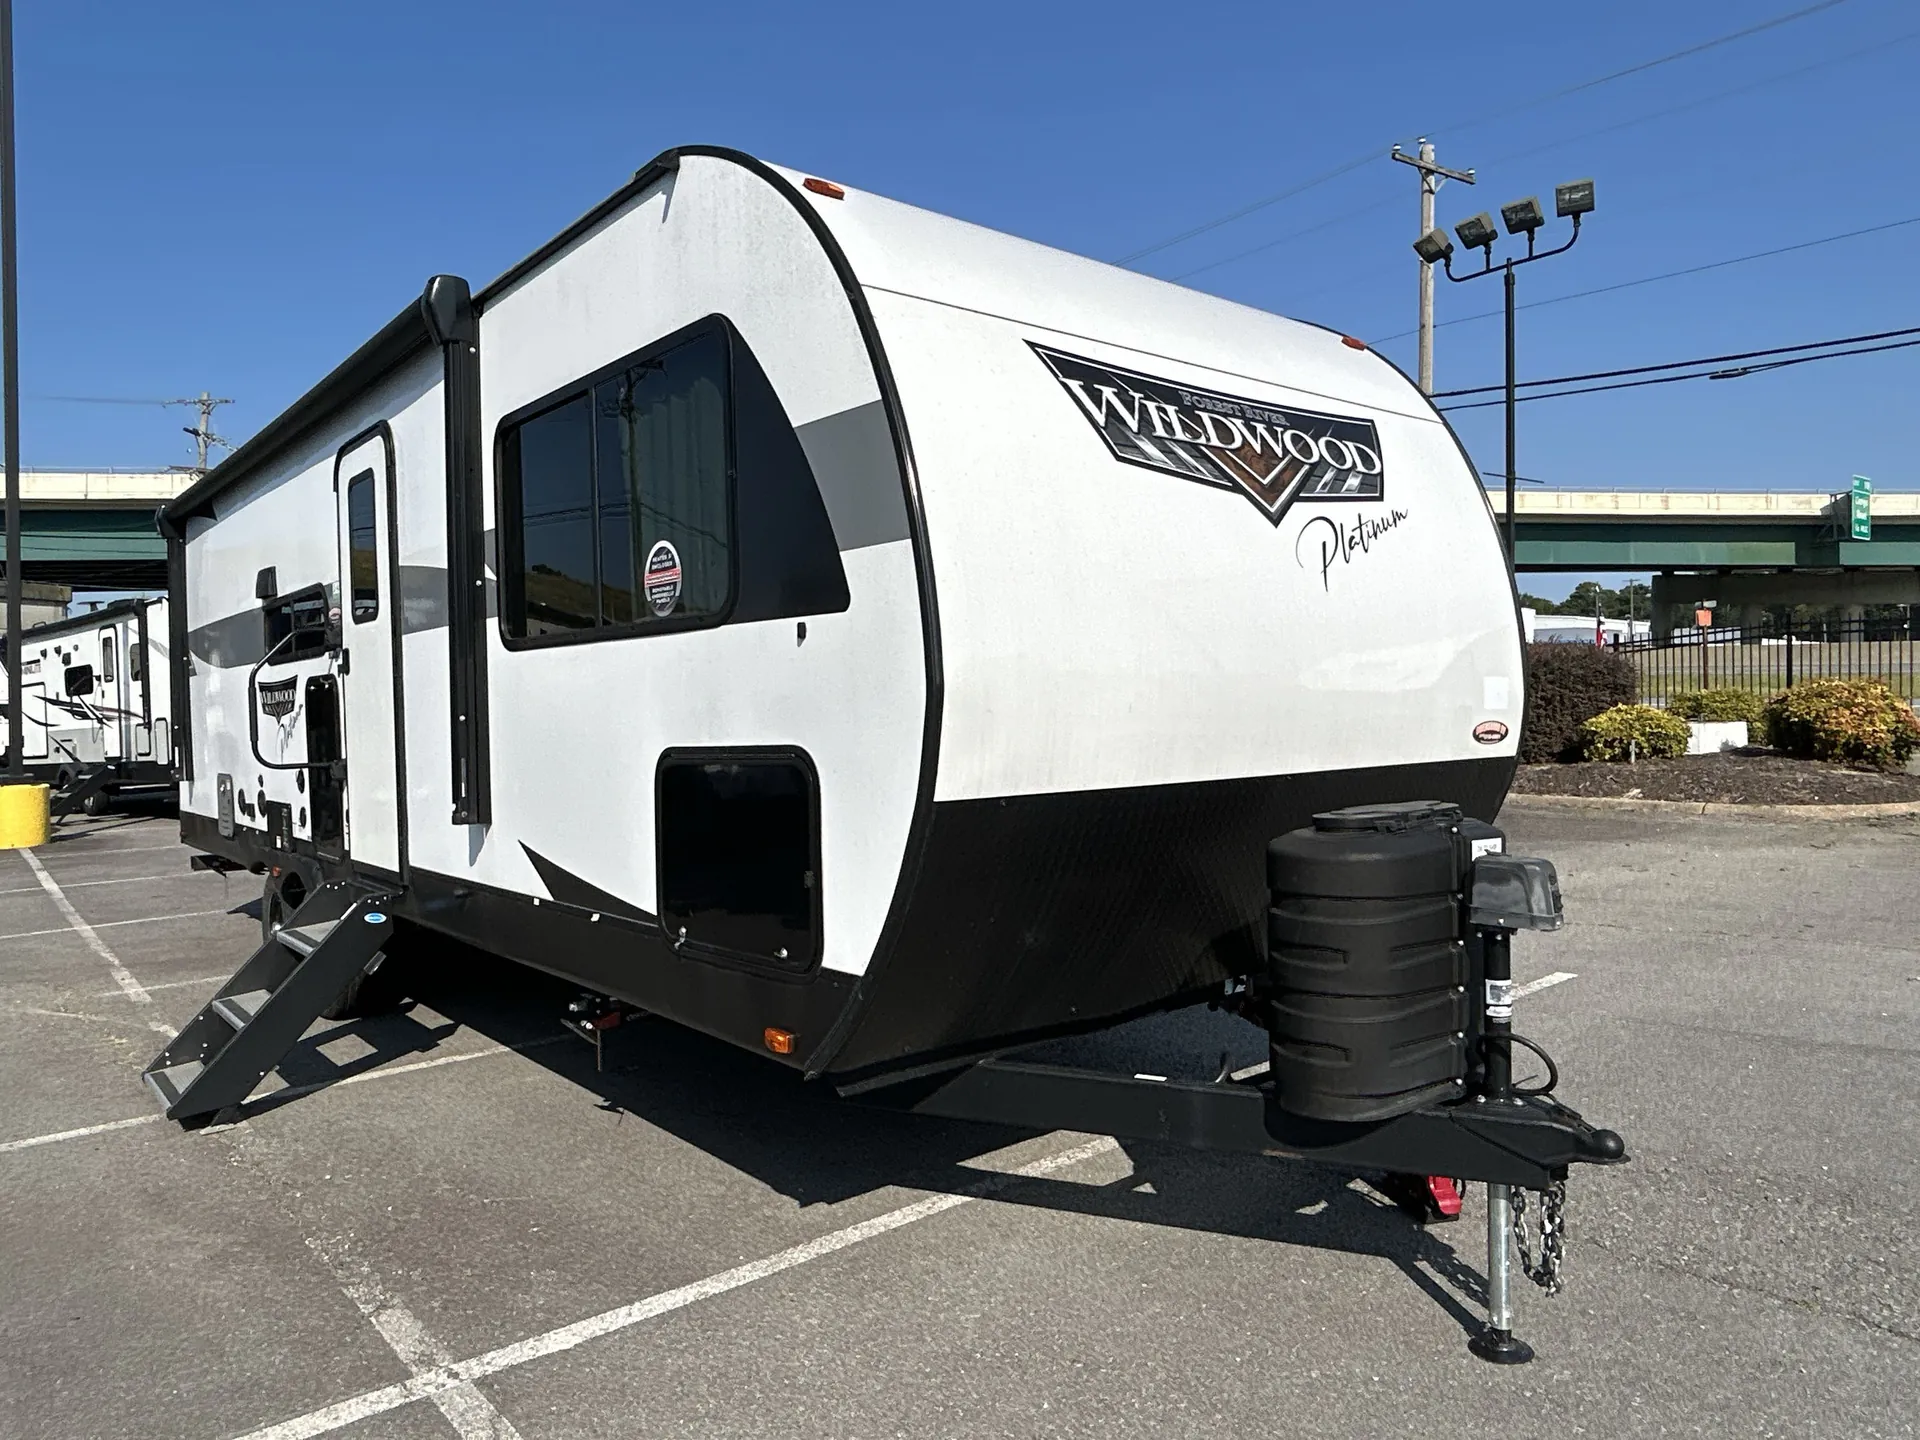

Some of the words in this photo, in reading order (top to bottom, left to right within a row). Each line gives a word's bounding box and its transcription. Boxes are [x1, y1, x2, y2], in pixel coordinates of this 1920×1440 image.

[1059, 376, 1382, 475] WILDWOOD
[1178, 390, 1241, 416] FOREST
[1295, 508, 1409, 592] Platinum
[260, 689, 296, 704] WILDWOOD
